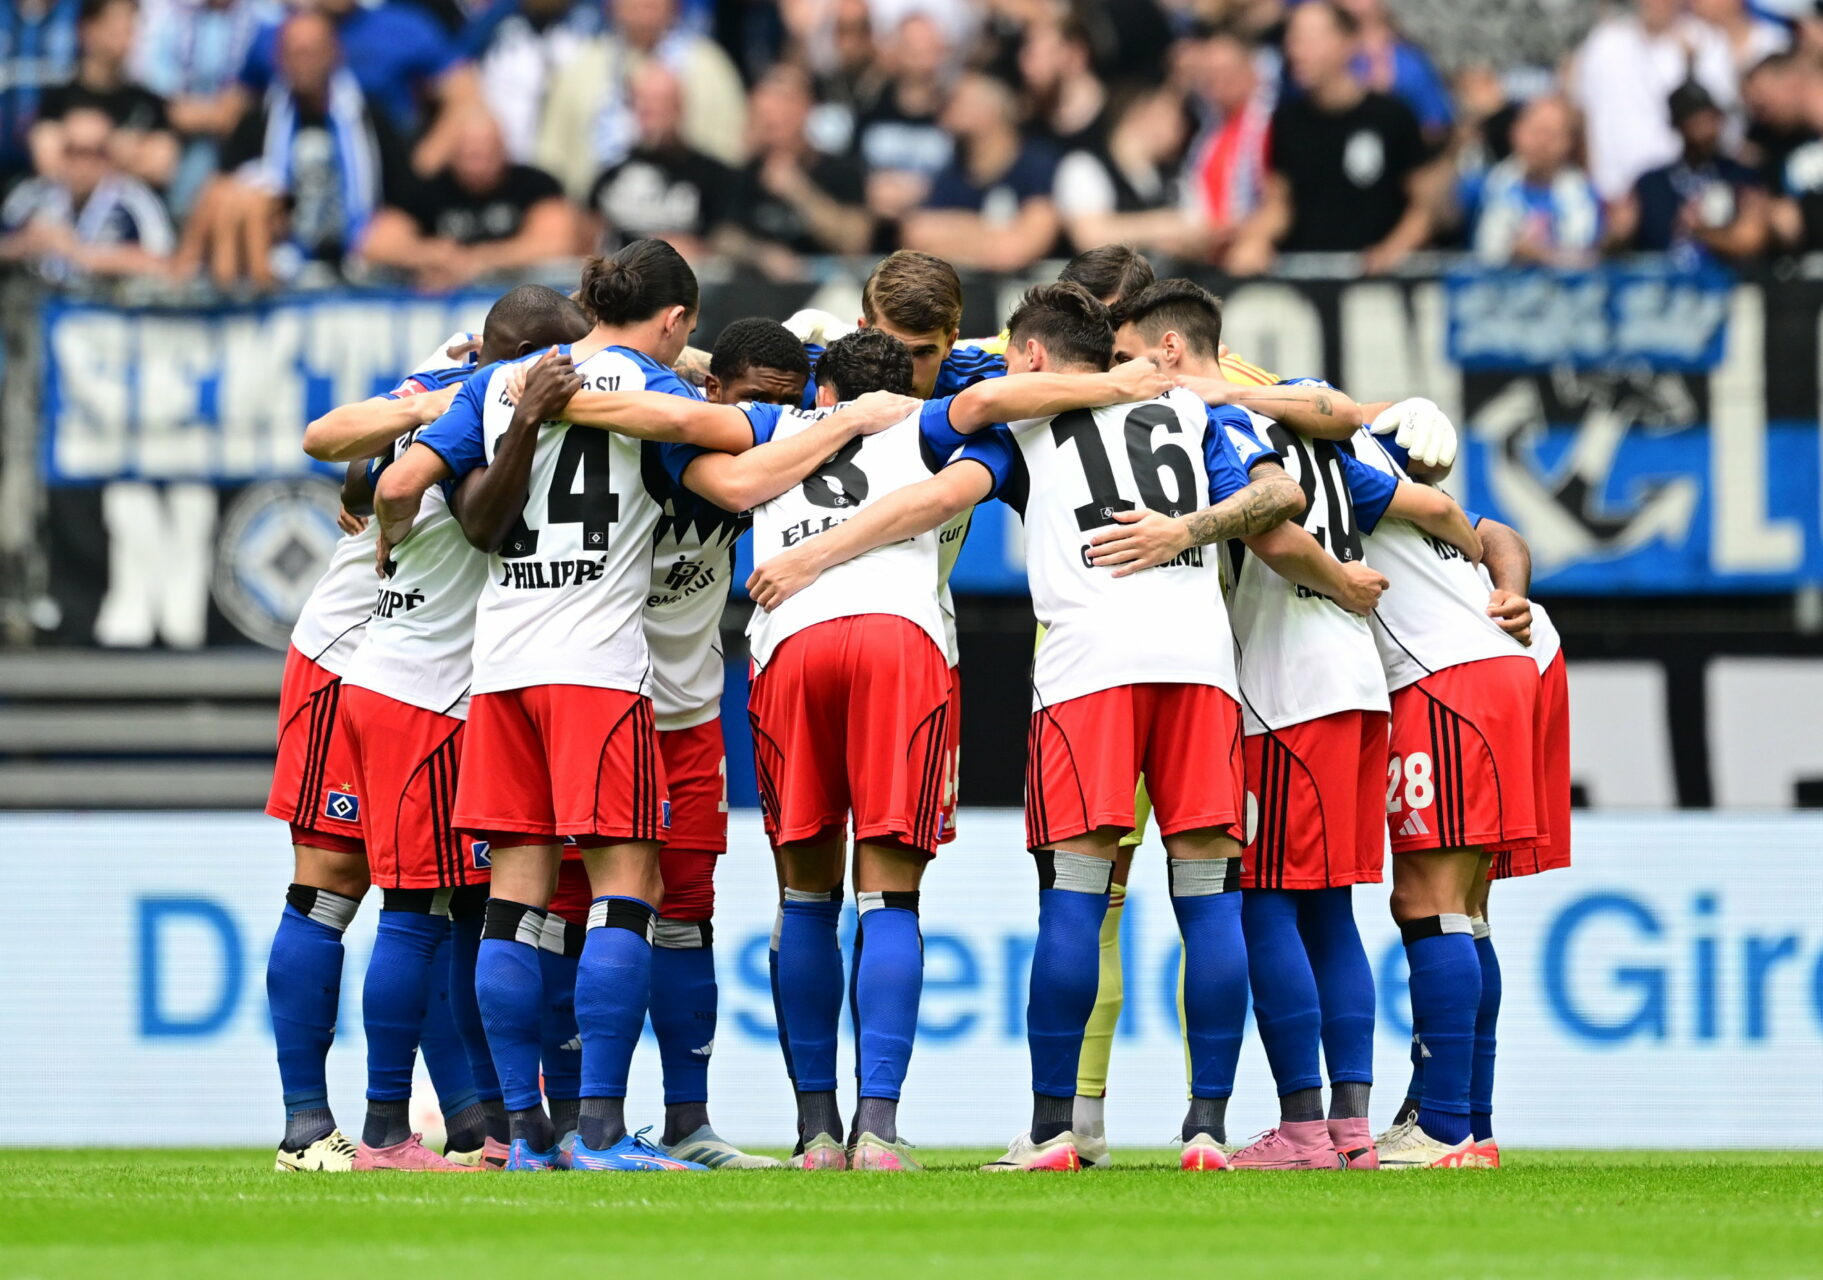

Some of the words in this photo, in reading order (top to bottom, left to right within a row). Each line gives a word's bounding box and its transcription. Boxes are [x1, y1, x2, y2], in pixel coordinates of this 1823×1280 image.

[52, 302, 484, 477] SEKT
[1050, 404, 1198, 532] 16
[1266, 422, 1365, 563] 20
[1387, 751, 1435, 814] 28
[1543, 892, 1823, 1041] Gir
